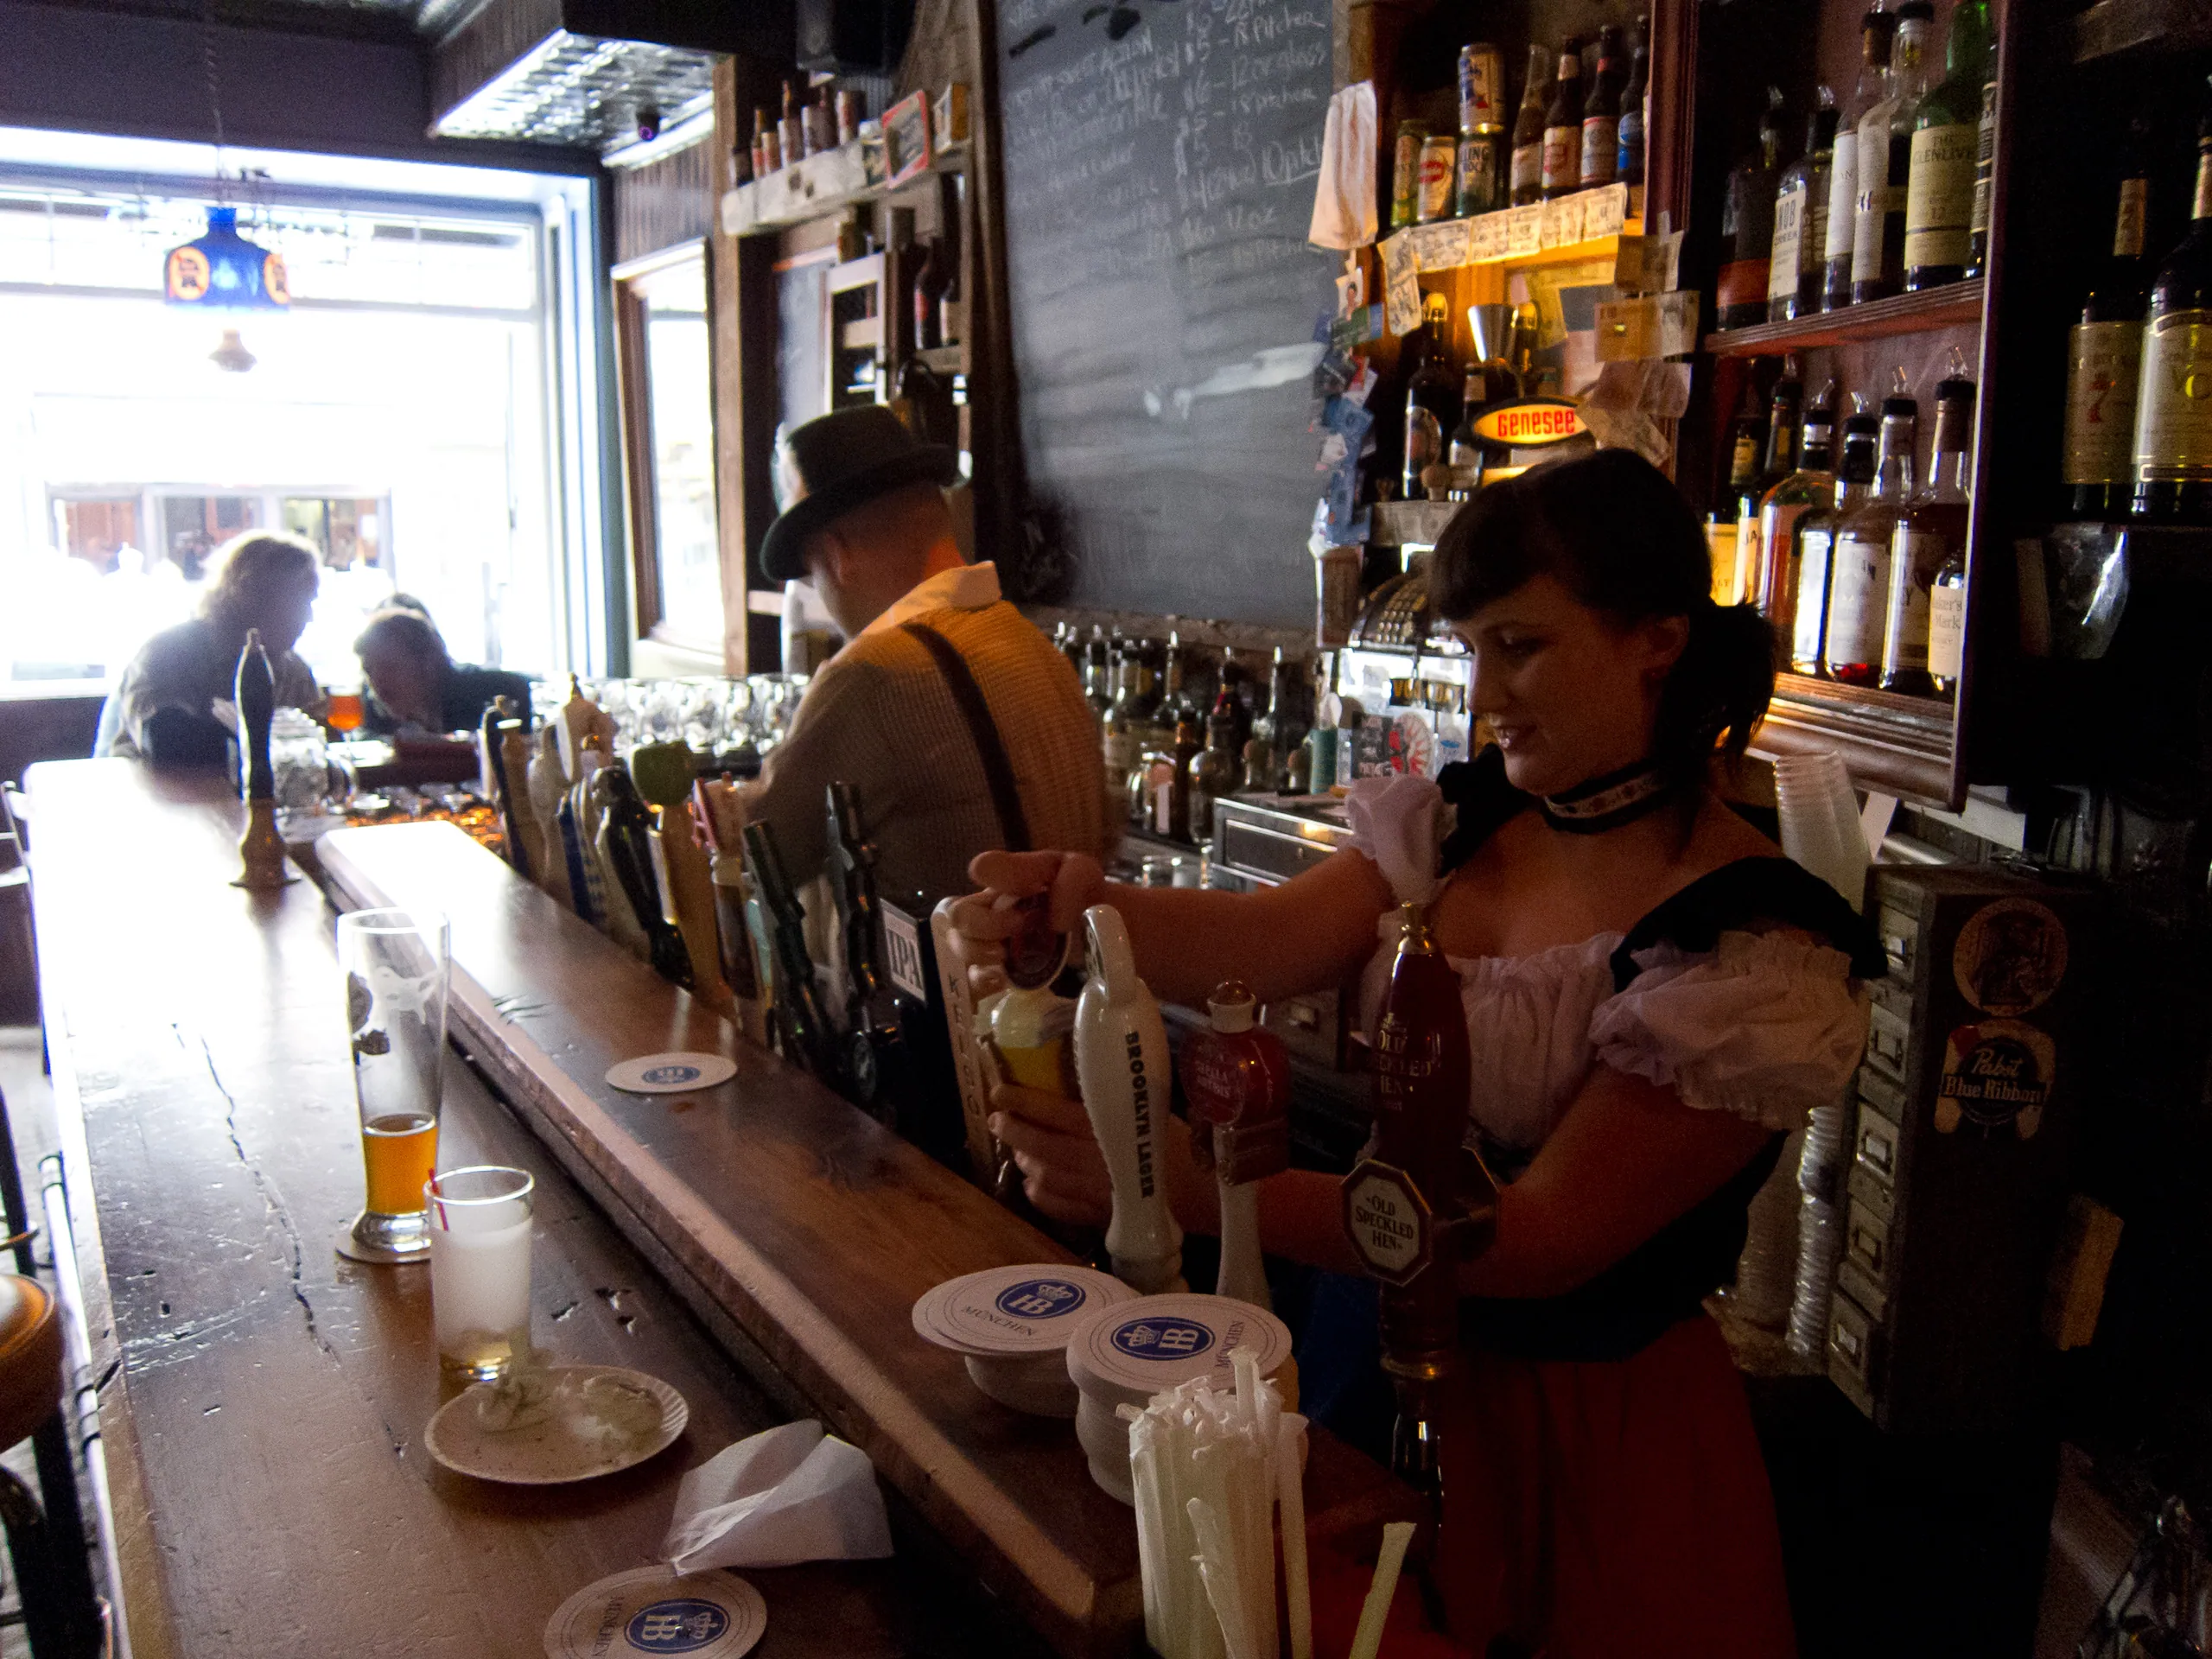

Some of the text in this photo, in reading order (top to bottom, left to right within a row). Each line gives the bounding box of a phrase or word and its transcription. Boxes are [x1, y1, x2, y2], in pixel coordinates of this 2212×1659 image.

[888, 928, 923, 991] IPA
[1971, 1047, 2025, 1077] Pabst
[1125, 1032, 1152, 1139] BROOKLYN
[1945, 1075, 2043, 1104] Blue Ribbon
[1137, 1140, 1155, 1198] LAGER
[1355, 1205, 1414, 1240] SPECKLED
[1007, 1294, 1055, 1314] HB
[1158, 1327, 1200, 1351] HB
[641, 1614, 683, 1641] HB
